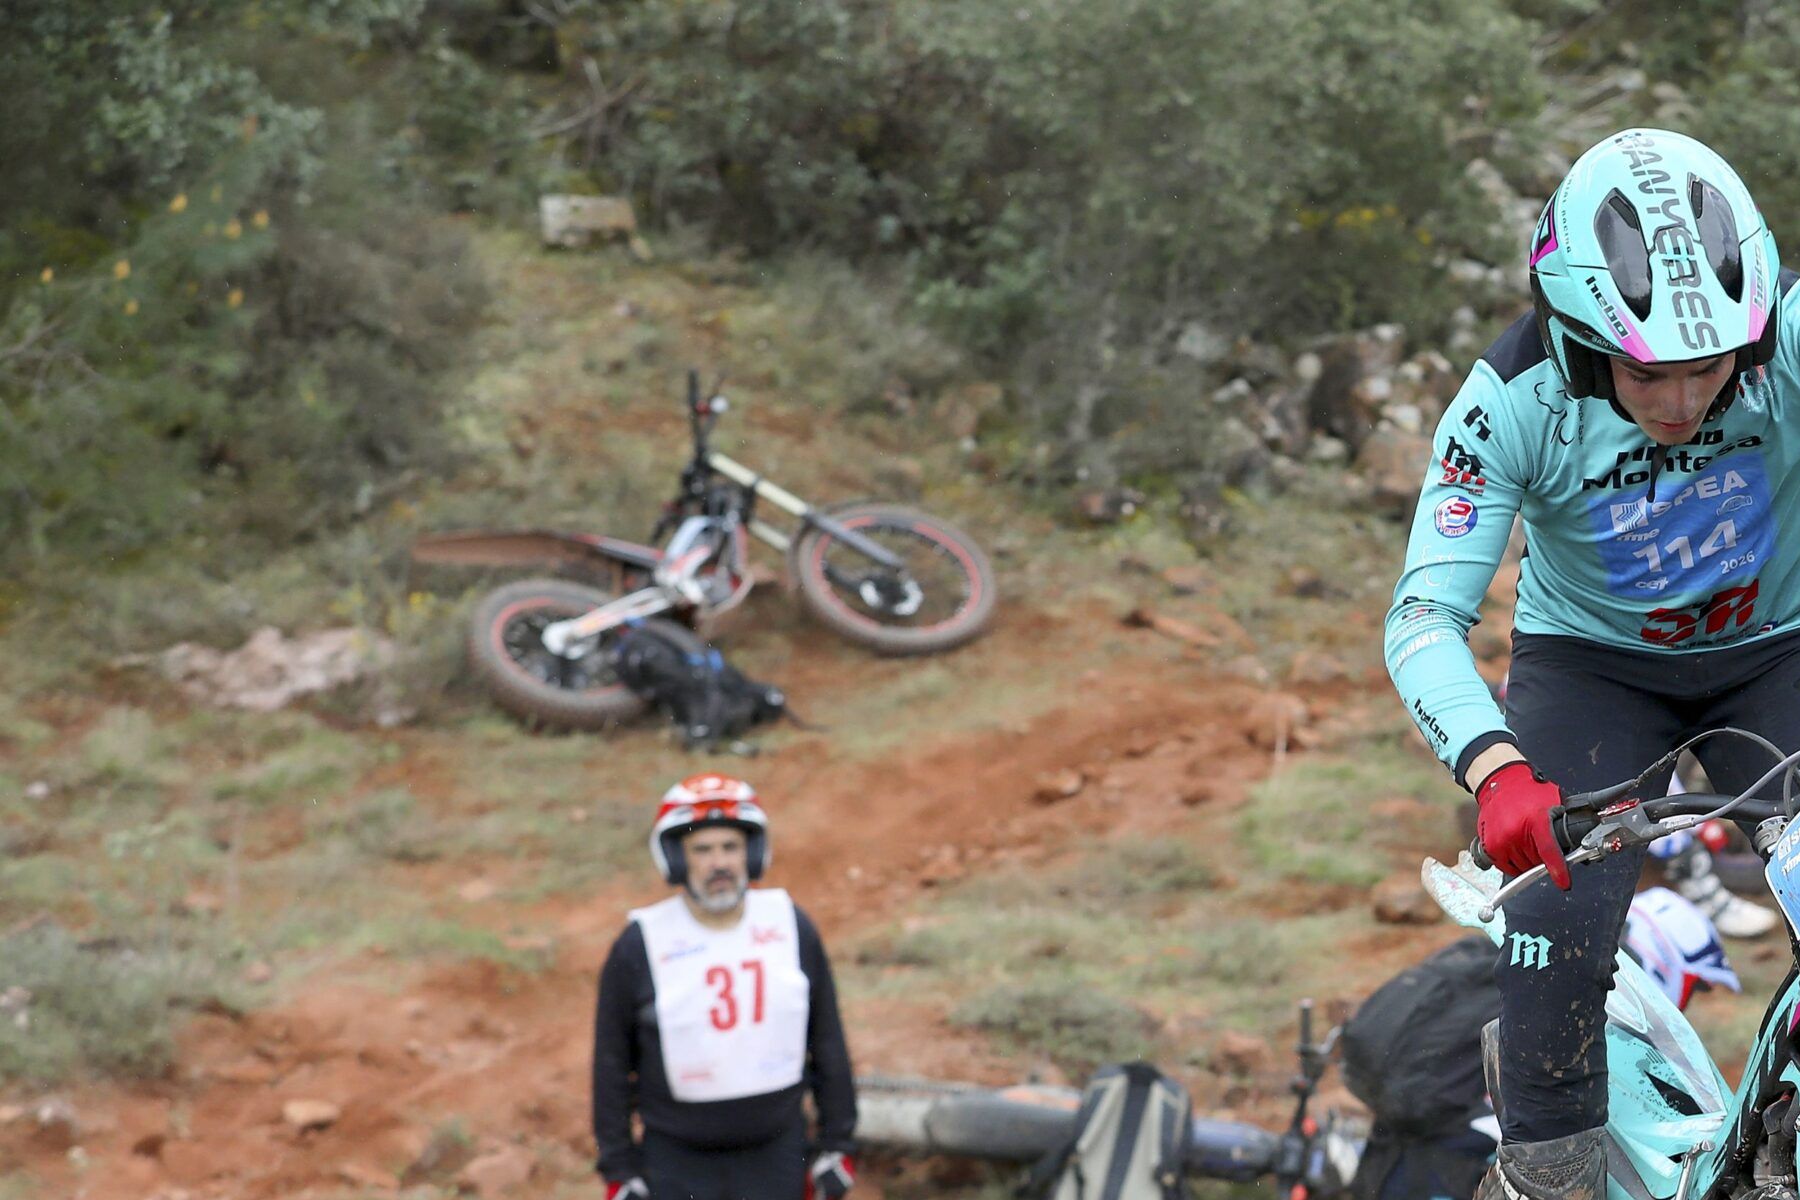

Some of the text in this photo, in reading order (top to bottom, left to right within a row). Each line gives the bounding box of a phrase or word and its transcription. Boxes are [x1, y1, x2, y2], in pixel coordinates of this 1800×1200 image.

[1585, 276, 1629, 339] hebo
[1633, 519, 1741, 573] 114
[1719, 550, 1756, 575] 2026
[705, 959, 765, 1033] 37
